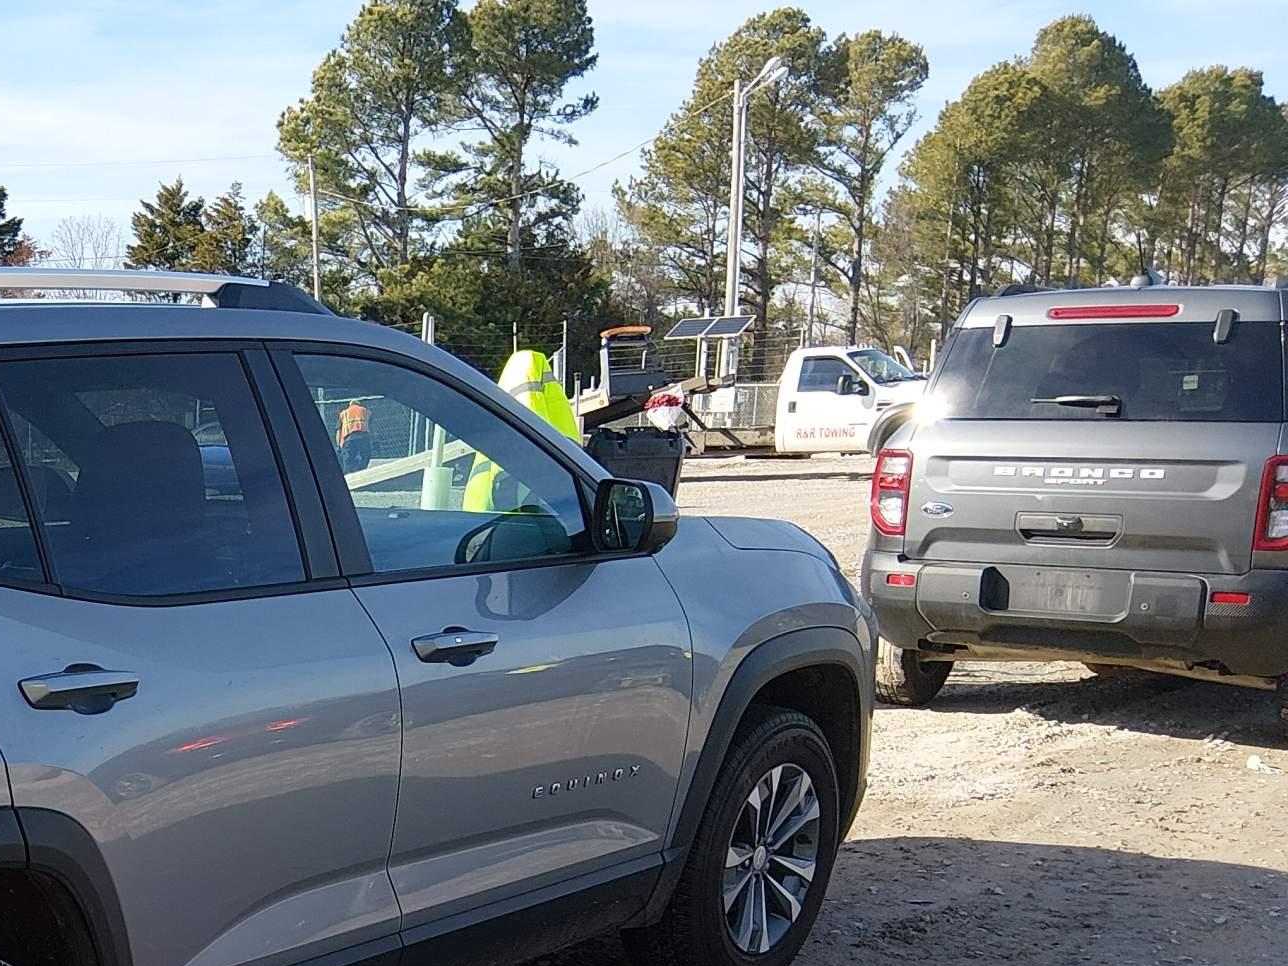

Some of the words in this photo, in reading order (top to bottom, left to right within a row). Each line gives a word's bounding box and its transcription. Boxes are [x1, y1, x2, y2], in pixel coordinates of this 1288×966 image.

[796, 427, 816, 439] R&R
[819, 426, 856, 438] TOWING
[993, 465, 1166, 479] BRONCO
[1043, 478, 1108, 486] SPORT
[531, 764, 641, 799] EQUINOX
